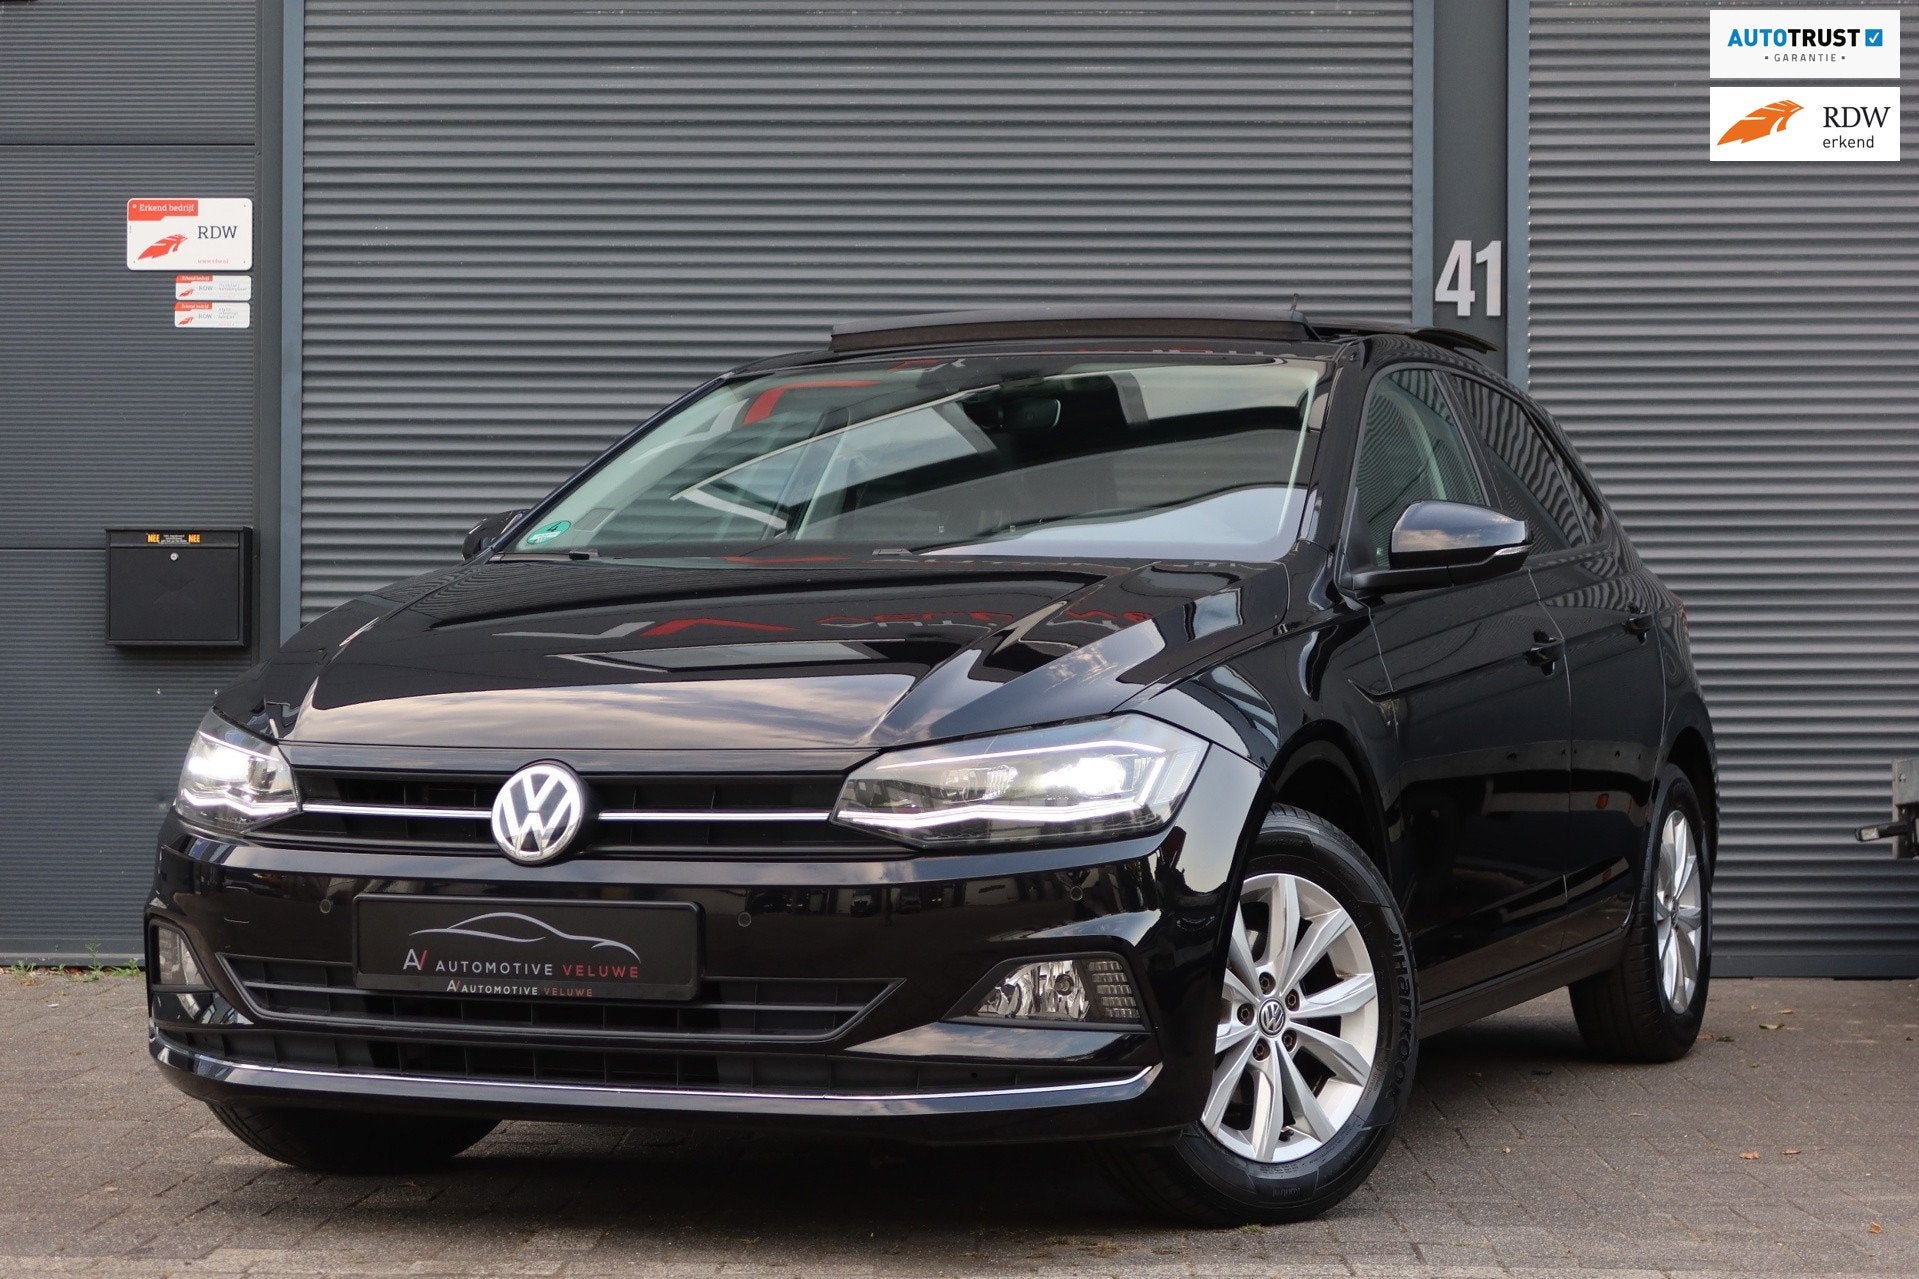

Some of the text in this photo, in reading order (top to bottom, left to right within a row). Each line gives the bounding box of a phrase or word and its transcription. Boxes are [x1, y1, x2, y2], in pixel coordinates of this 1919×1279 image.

[139, 203, 195, 213] Erkend bedrijf
[197, 225, 238, 239] RDW
[1435, 240, 1502, 317] 41
[435, 960, 553, 976] AUTOMOTIVE
[562, 964, 639, 978] VELUWE
[461, 984, 538, 996] AUTOMOTIVE
[543, 986, 593, 997] VELUWE
